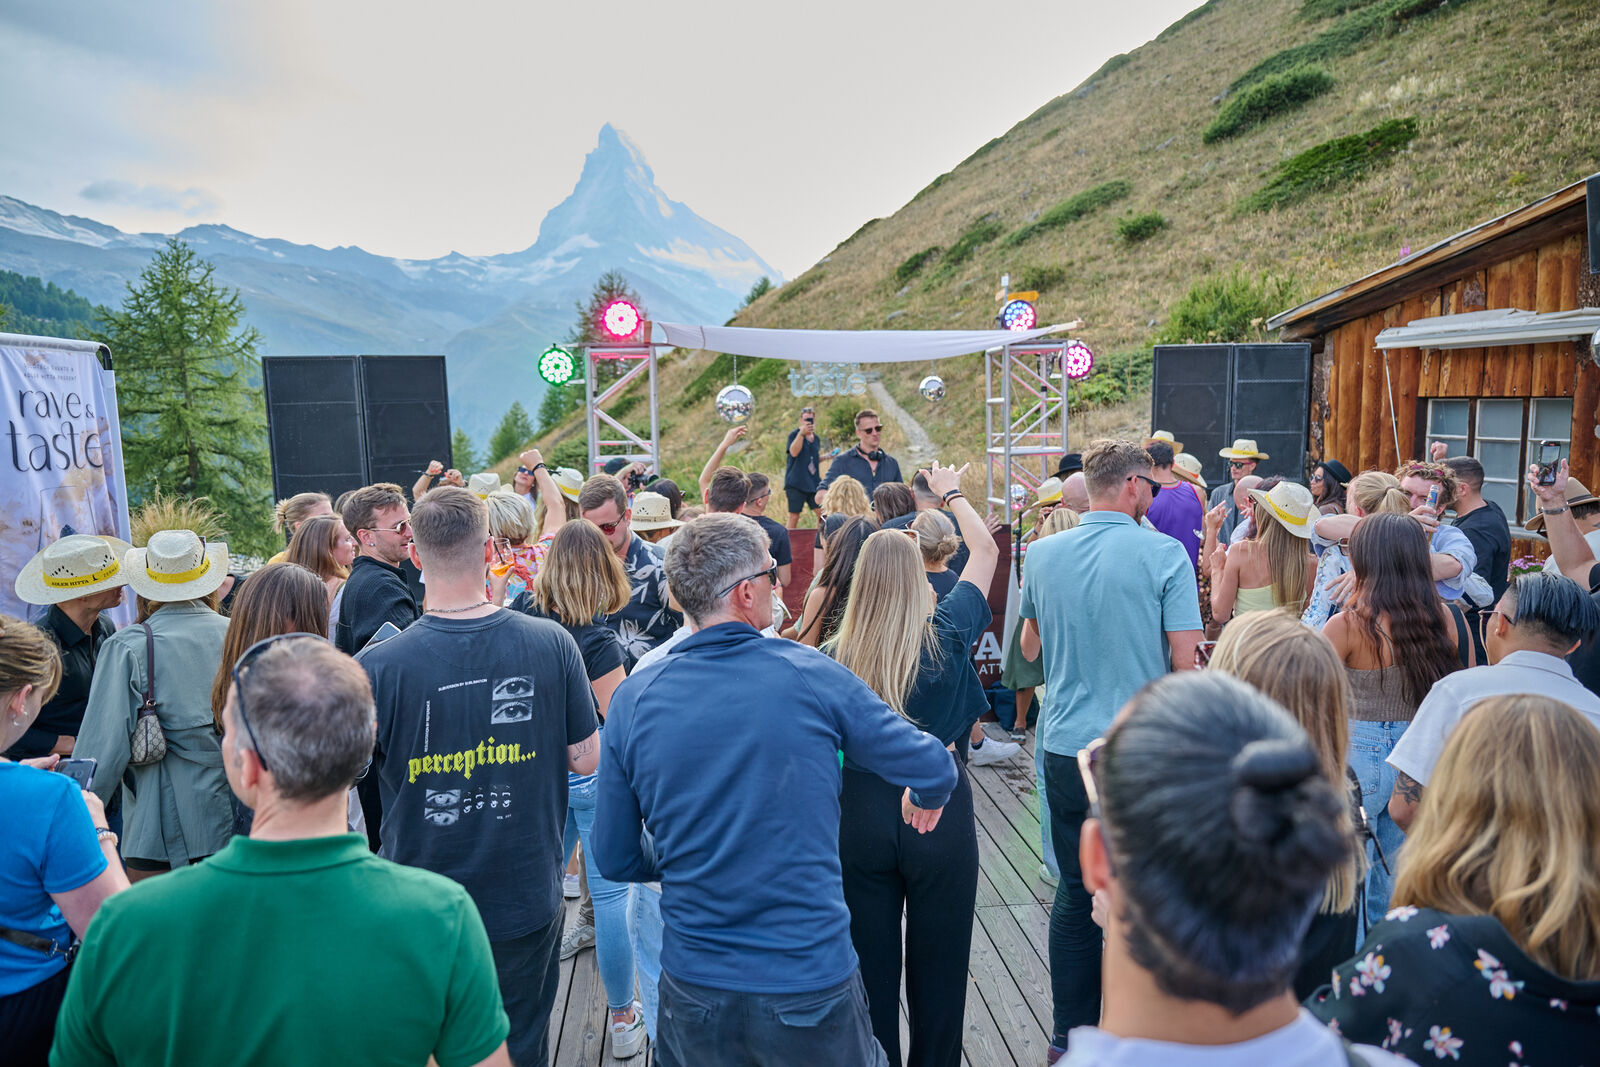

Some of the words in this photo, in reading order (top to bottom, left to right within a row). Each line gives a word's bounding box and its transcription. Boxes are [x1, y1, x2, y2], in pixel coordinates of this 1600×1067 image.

[787, 367, 866, 397] taste
[19, 389, 81, 418] rave
[85, 403, 95, 418] &
[5, 420, 104, 472] taste
[69, 579, 89, 587] HITTA
[972, 631, 1002, 660] A
[978, 663, 1002, 675] ATT
[408, 736, 536, 784] perception...
